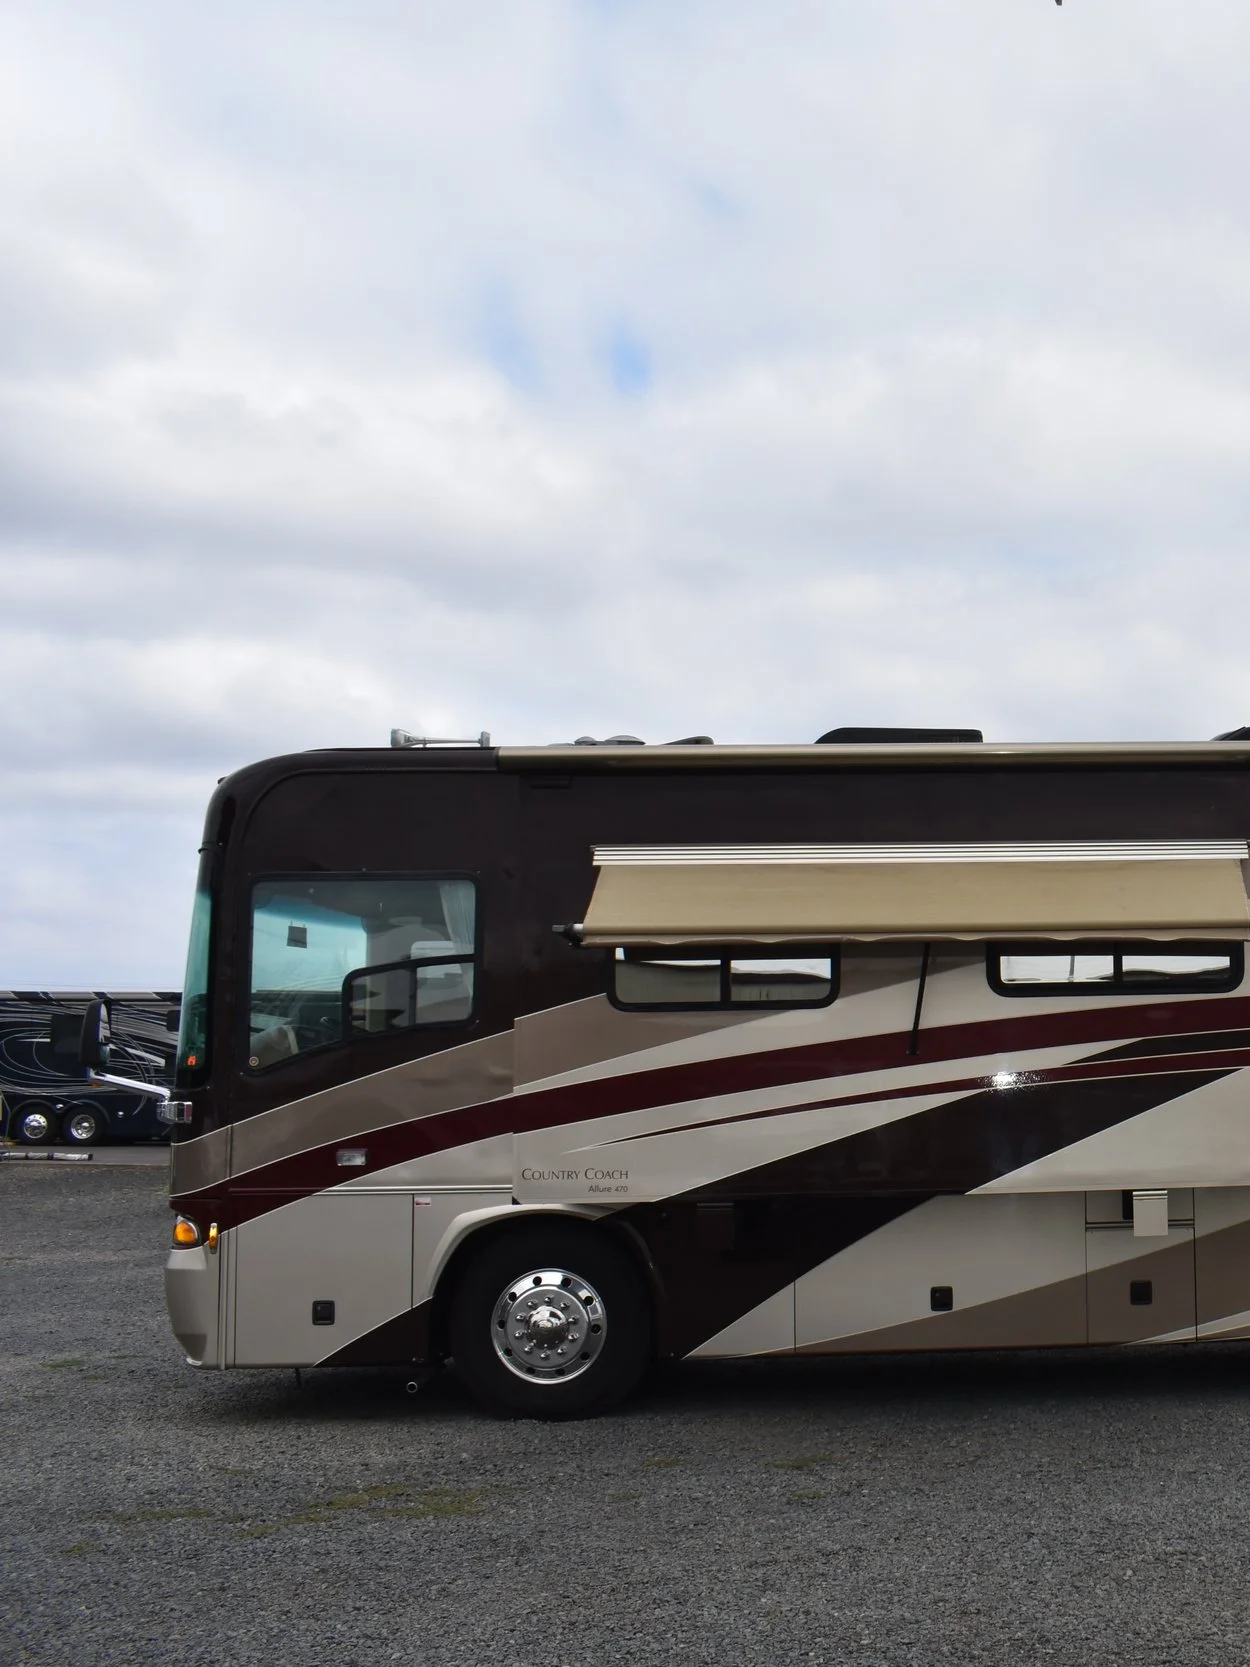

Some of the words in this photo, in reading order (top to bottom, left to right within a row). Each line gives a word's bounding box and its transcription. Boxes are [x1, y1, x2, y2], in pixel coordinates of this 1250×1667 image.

[521, 1167, 580, 1181] COUNTRY
[584, 1167, 629, 1180] COACH
[588, 1185, 612, 1193] Allure
[614, 1185, 628, 1193] 470
